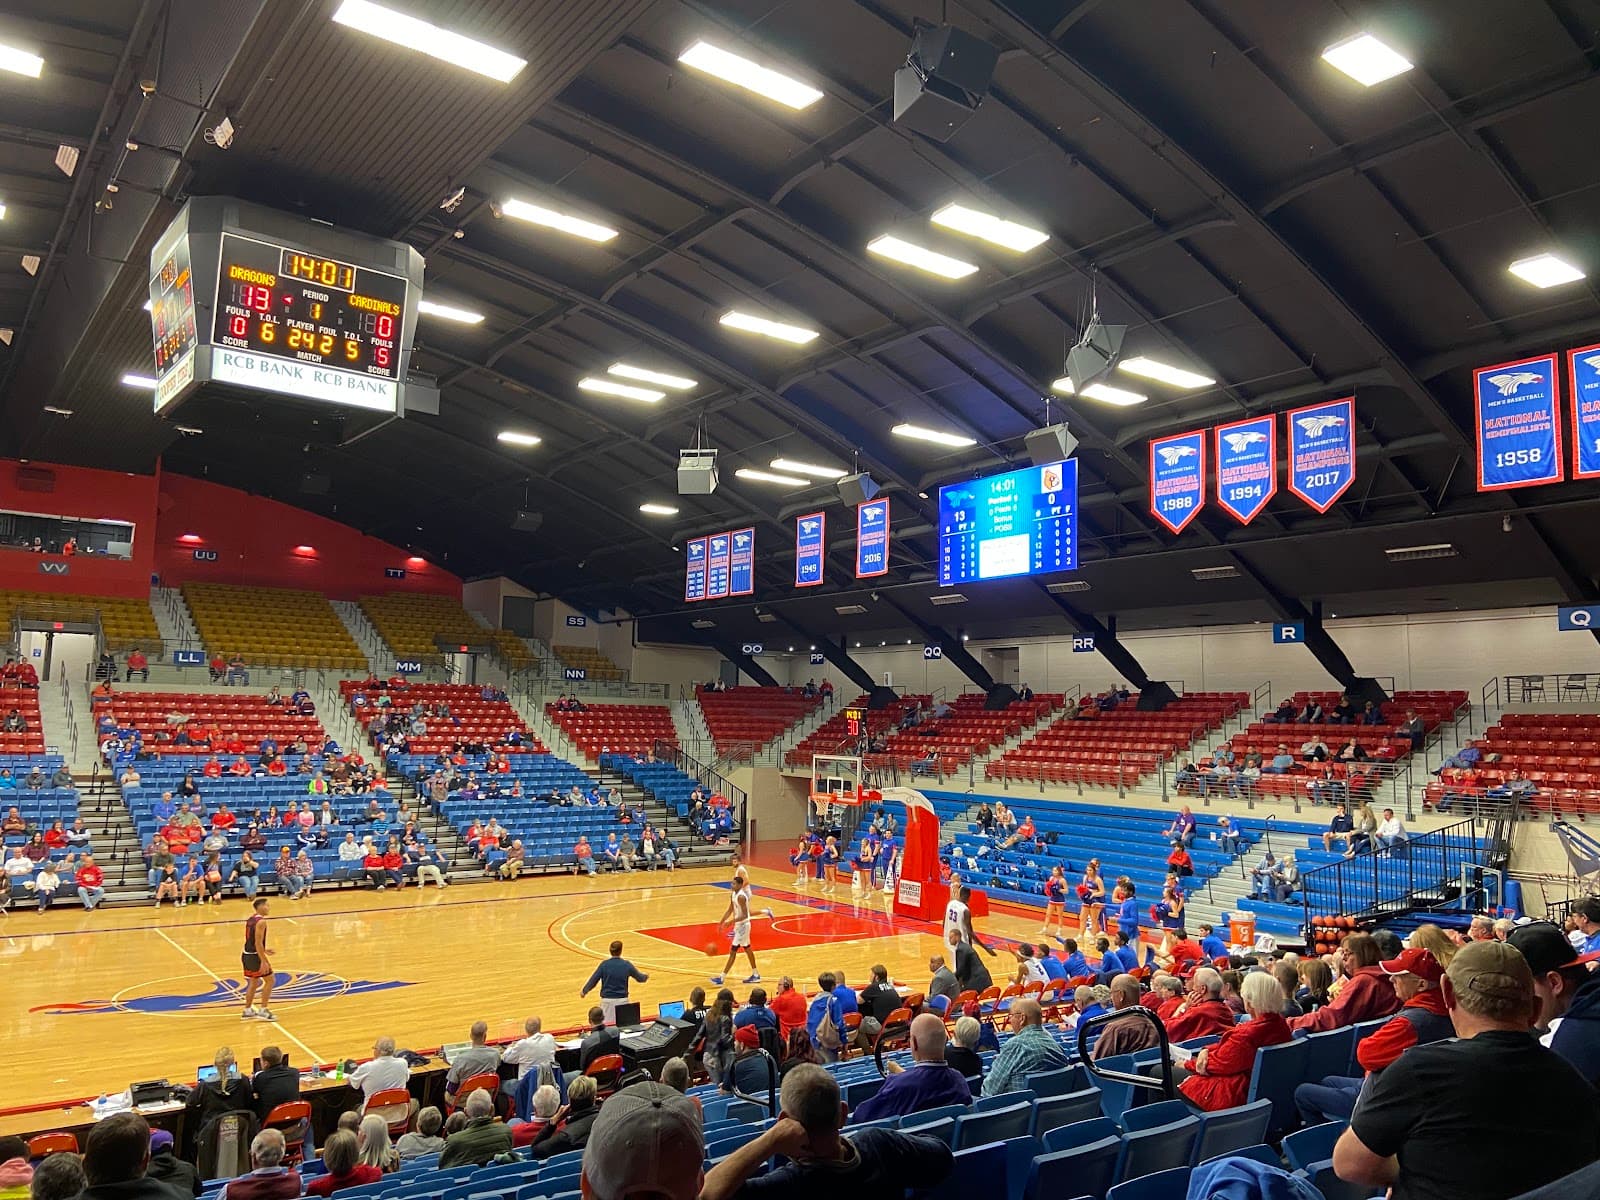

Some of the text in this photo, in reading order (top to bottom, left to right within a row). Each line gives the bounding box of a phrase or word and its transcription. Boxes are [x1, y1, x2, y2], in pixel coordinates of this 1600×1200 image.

[230, 265, 276, 287] DRAGONS
[292, 254, 350, 288] 14:01
[246, 286, 269, 310] 13
[302, 289, 329, 302] PERIOD
[226, 305, 251, 318] FOULS
[350, 294, 400, 316] CARDINALS
[259, 313, 280, 324] T.O.L.
[233, 317, 246, 335] 0
[261, 323, 274, 341] 6
[287, 319, 315, 332] PLAYER
[319, 326, 337, 337] FOUL
[378, 316, 392, 338] 0
[222, 335, 249, 348] SCORE
[289, 328, 315, 349] 24
[344, 331, 363, 342] T.O.L.
[371, 336, 393, 349] FOULS
[320, 335, 333, 353] 2
[346, 341, 358, 360] 5
[296, 351, 322, 362] MATCH
[377, 347, 389, 365] 5
[223, 353, 387, 395] RCB BANK RCB BANK
[367, 365, 391, 377] SCORE
[1487, 393, 1544, 407] MEN'S BASKETBALL
[1485, 410, 1550, 429] NATIONAL
[1296, 446, 1349, 464] NATIONAL
[1496, 448, 1541, 467] 1958
[1222, 461, 1269, 477] NATIONAL
[991, 478, 1016, 493] 14:01
[1156, 474, 1198, 488] NATIONAL
[1305, 471, 1340, 488] 2017
[1230, 484, 1262, 500] 1994
[1048, 493, 1055, 505] 0
[1163, 496, 1193, 511] 1988
[954, 510, 966, 522] 13
[195, 550, 217, 560] UU
[864, 553, 882, 563] 2016
[41, 562, 67, 573] VV
[387, 568, 404, 577] TT
[568, 617, 584, 626] SS
[1570, 610, 1591, 627] Q
[1281, 626, 1296, 640] R
[742, 644, 763, 653] OO
[1073, 638, 1094, 649] RR
[178, 653, 200, 663] LL
[810, 653, 824, 663] PP
[924, 647, 941, 657] QQ
[396, 662, 421, 672] MM
[566, 669, 584, 679] NN
[847, 720, 859, 736] 30
[949, 909, 958, 922] 33
